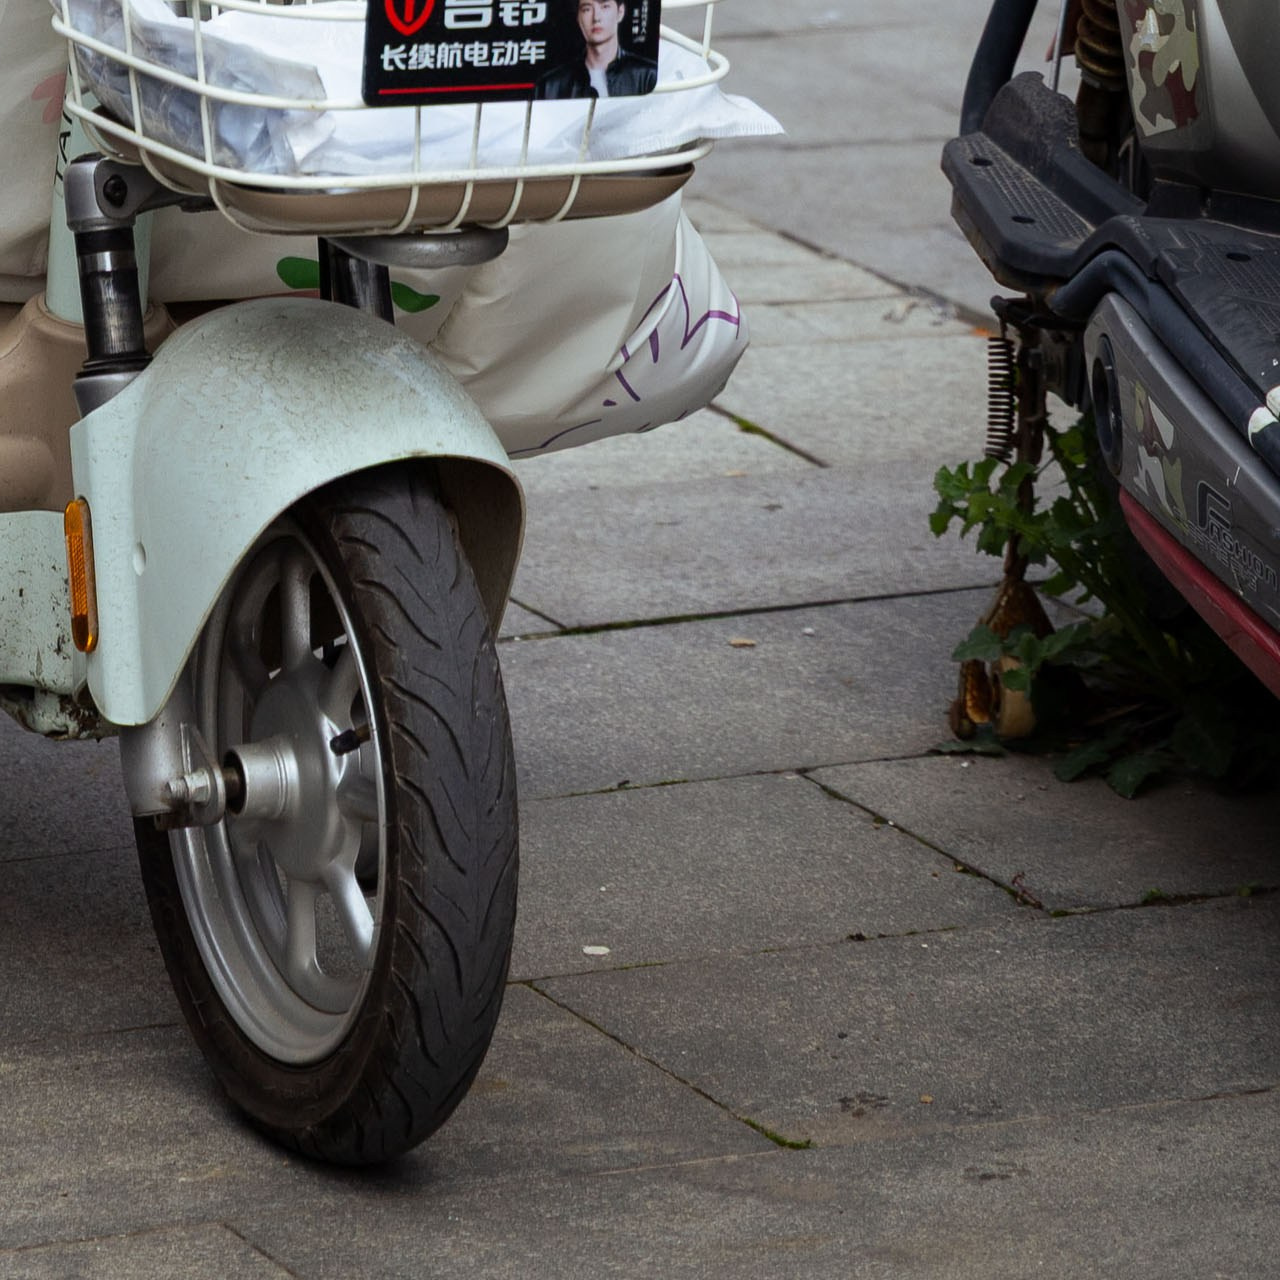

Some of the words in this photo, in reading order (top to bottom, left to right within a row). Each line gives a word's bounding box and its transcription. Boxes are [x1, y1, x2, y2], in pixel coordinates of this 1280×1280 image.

[380, 39, 547, 72] 长续航电动车
